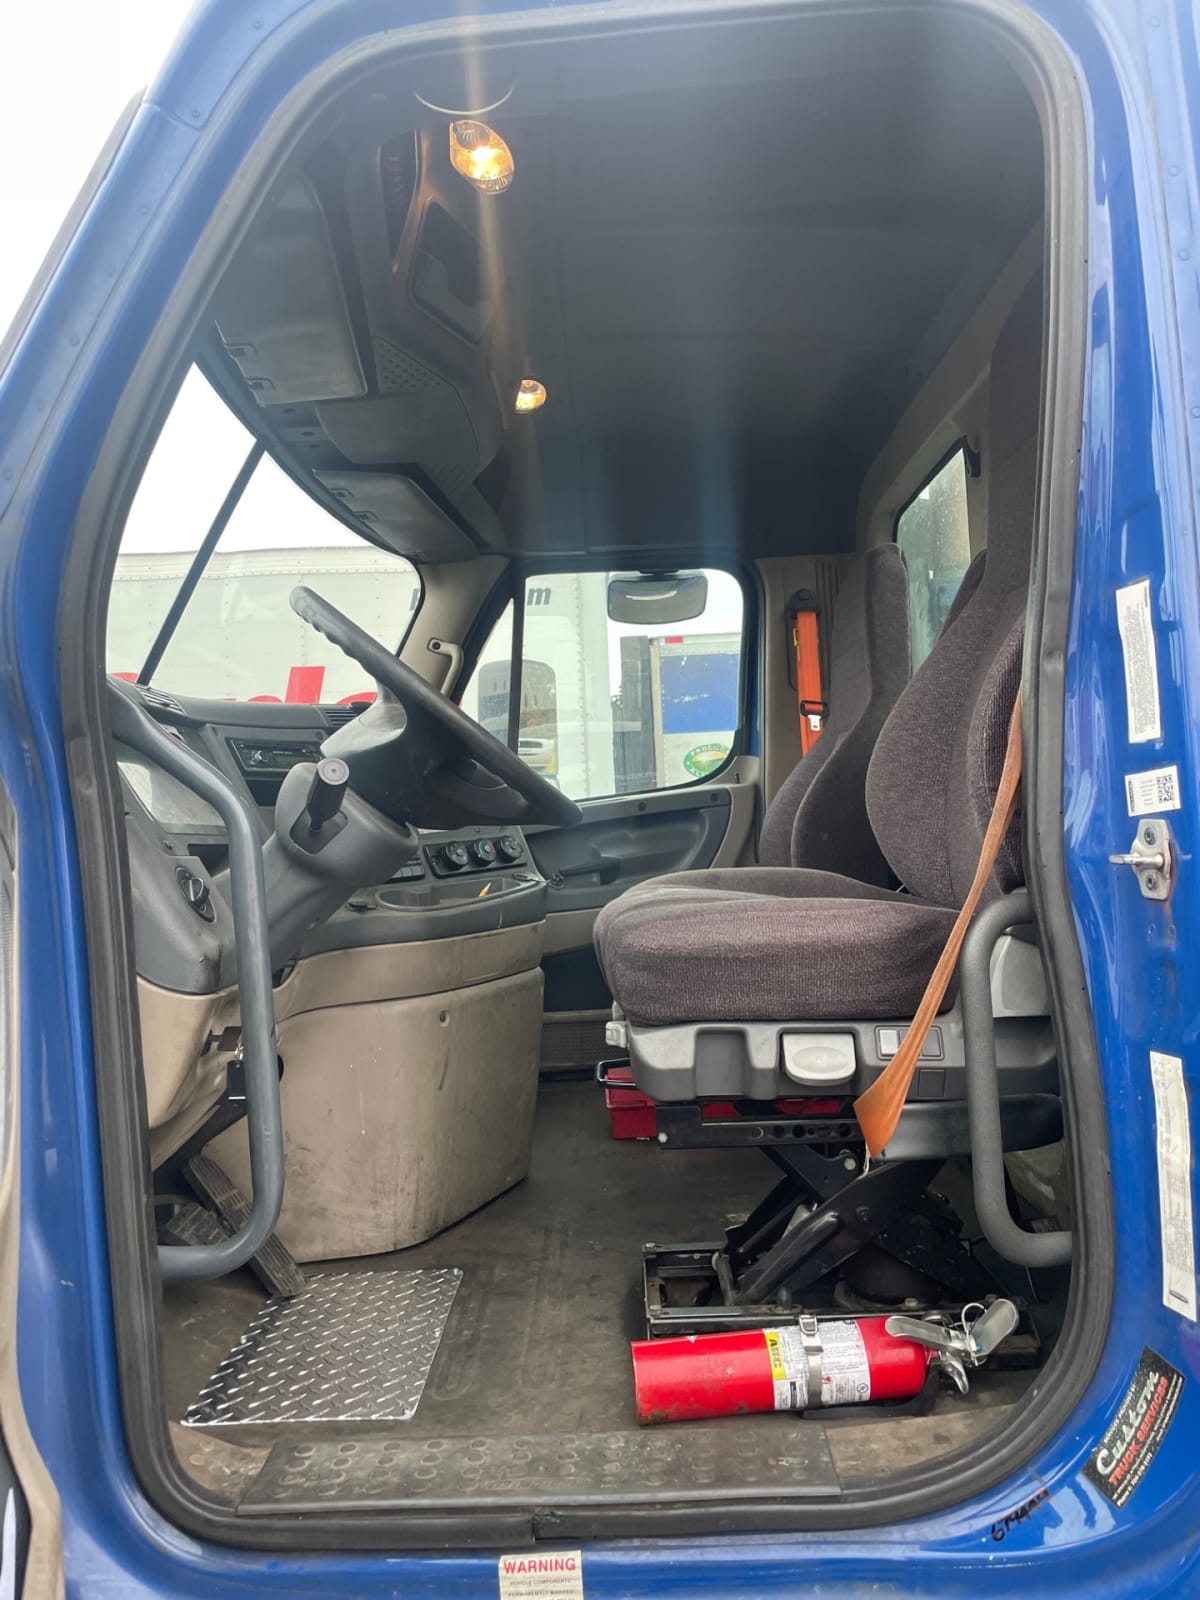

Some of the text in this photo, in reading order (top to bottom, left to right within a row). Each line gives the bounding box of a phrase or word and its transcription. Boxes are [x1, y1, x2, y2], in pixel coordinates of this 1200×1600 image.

[1097, 1371, 1159, 1475] Custom
[1109, 1440, 1140, 1486] TRUCK
[1137, 1376, 1168, 1441] SERVICES
[503, 1557, 576, 1575] WARNING
